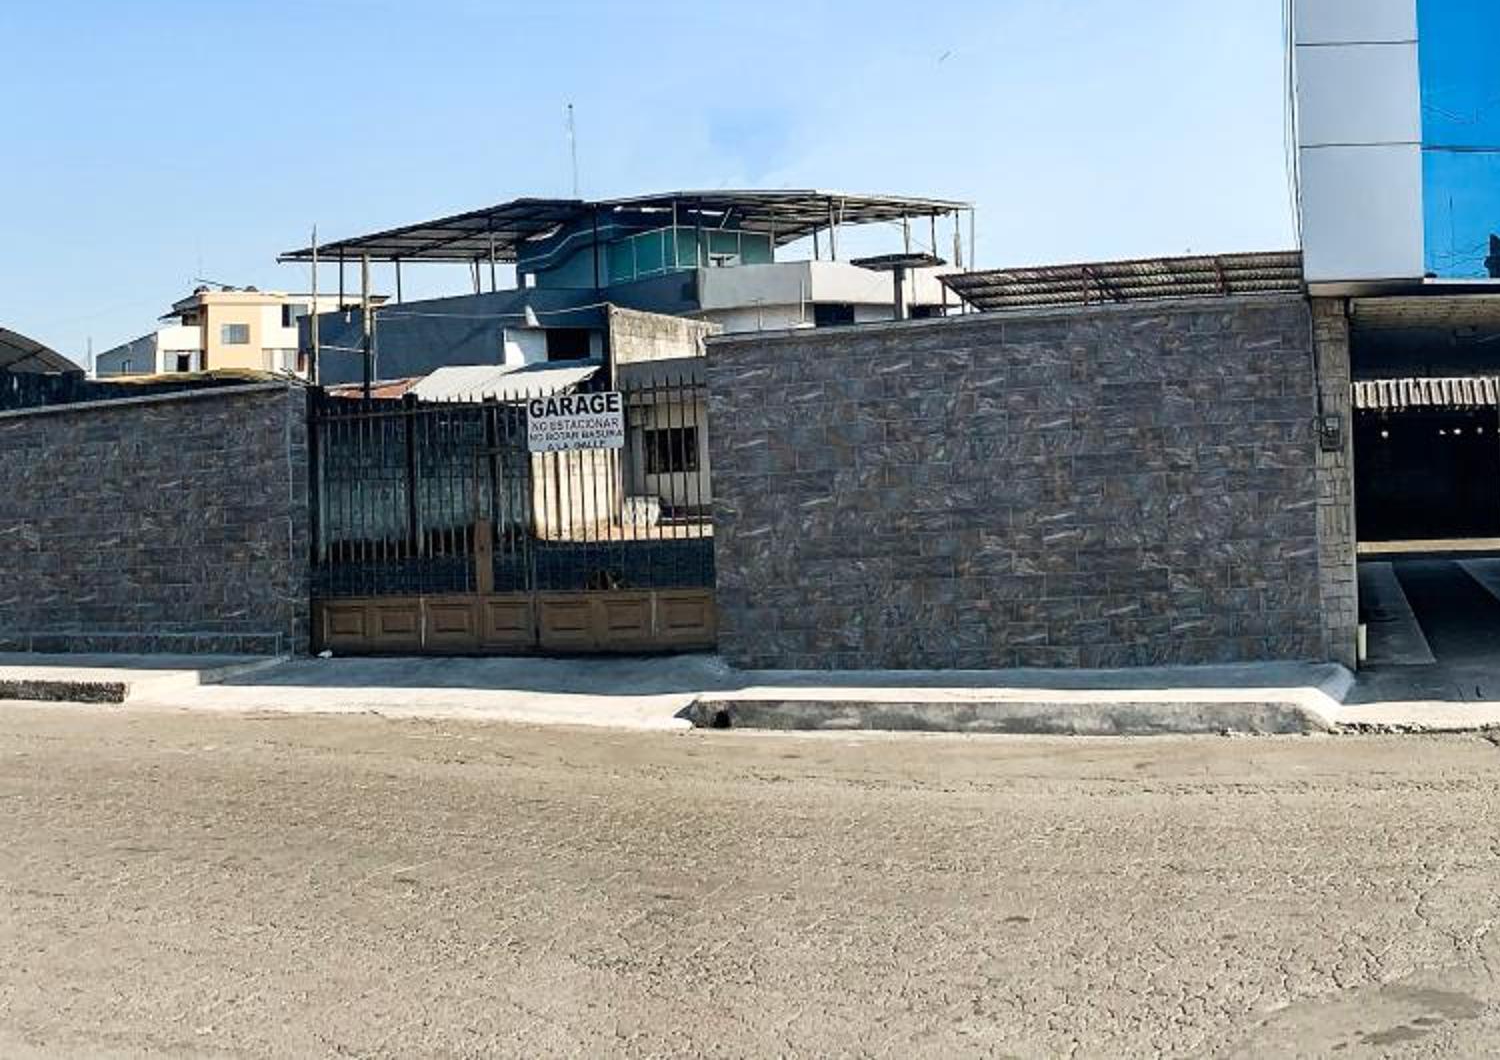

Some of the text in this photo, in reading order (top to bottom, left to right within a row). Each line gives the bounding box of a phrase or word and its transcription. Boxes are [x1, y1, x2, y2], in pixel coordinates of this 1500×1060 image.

[529, 393, 619, 419] GARAGE
[531, 418, 619, 432] NO ESTACIONAR
